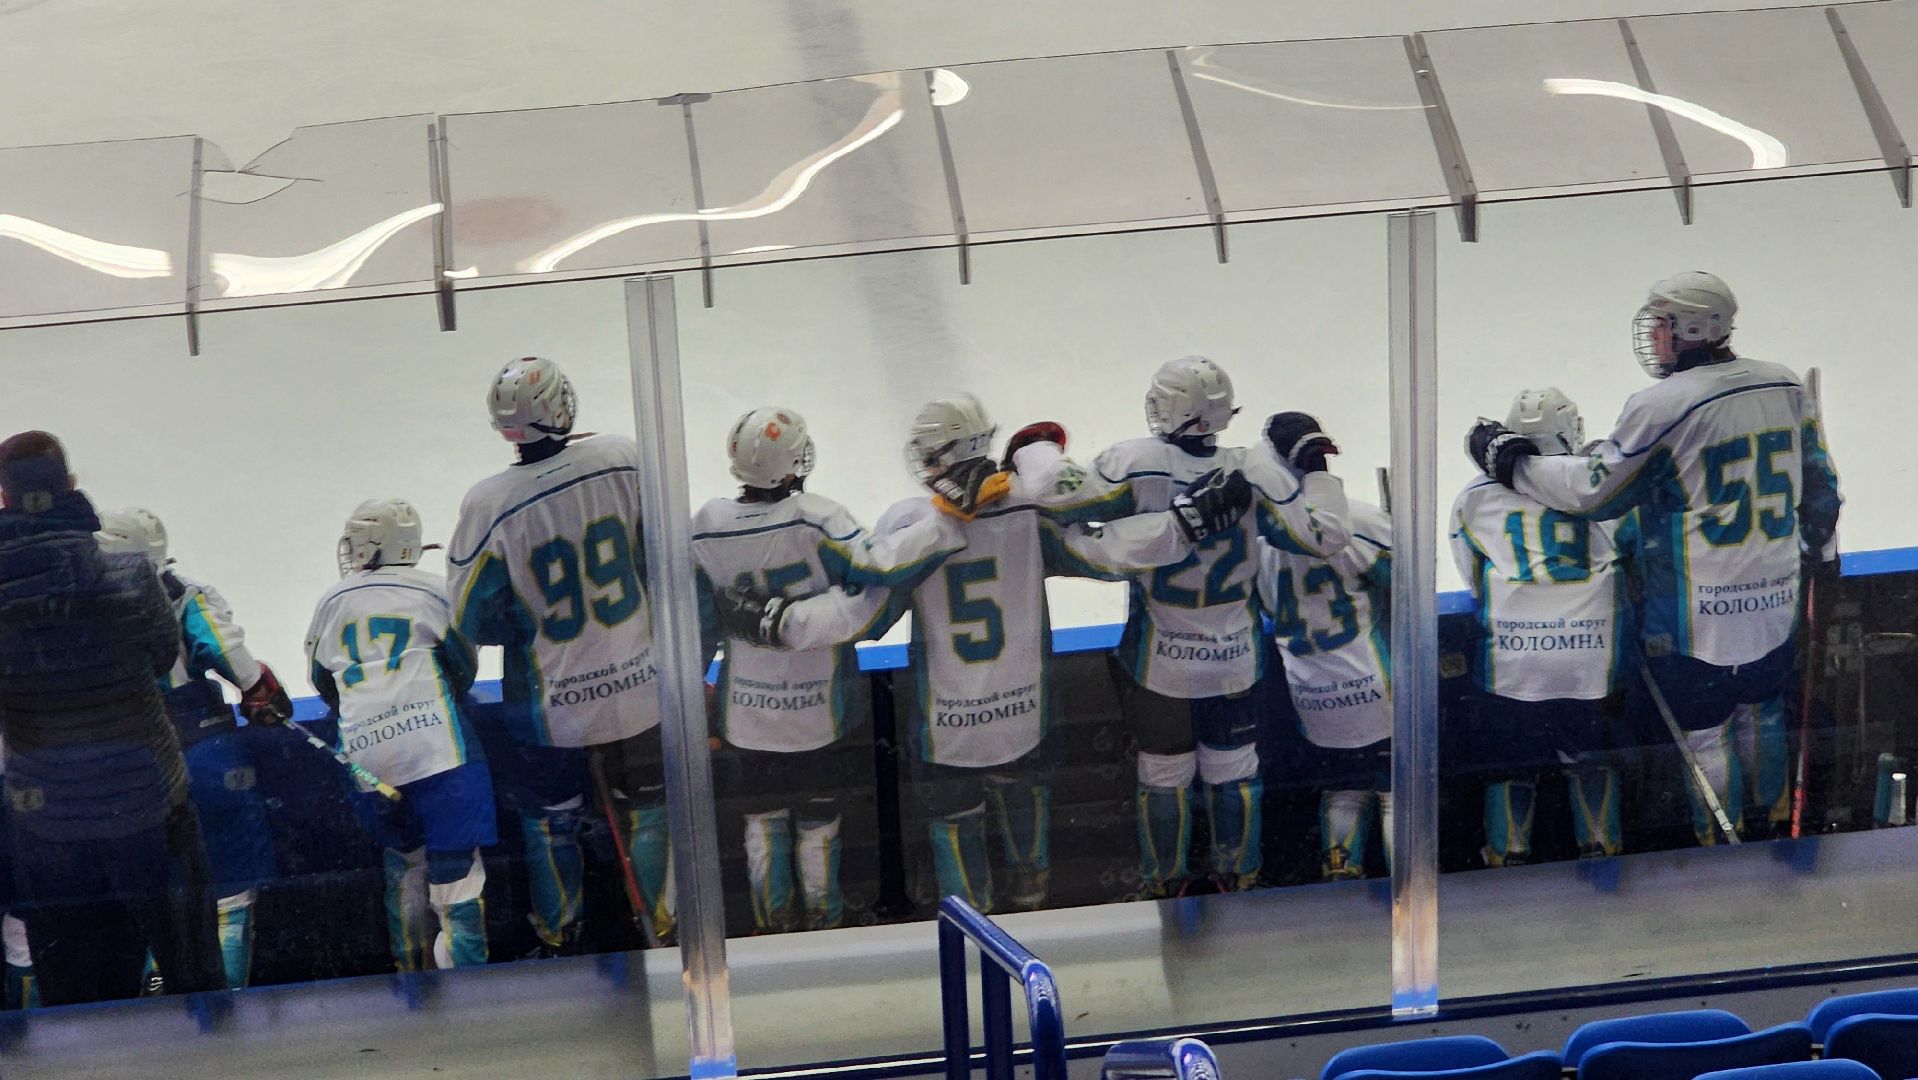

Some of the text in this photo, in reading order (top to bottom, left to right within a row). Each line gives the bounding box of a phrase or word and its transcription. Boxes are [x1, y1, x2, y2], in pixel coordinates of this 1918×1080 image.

[1699, 427, 1795, 548] 55
[529, 515, 642, 644] 99
[1150, 526, 1248, 609] 22
[1698, 578, 1768, 597] городской
[1698, 588, 1794, 615] КОЛОМНА
[944, 556, 1005, 665] 5
[1275, 563, 1360, 658] 43
[1497, 618, 1607, 632] городской округ
[340, 613, 413, 691] 17
[1156, 640, 1251, 661] КОЛОМНА
[1498, 633, 1605, 651] КОЛОМНА
[550, 664, 657, 707] КОЛОМНА
[1341, 674, 1376, 689] округ
[344, 704, 399, 733] ородской
[936, 698, 1037, 727] КОЛОМНА
[348, 712, 443, 754] КОЛОМНА
